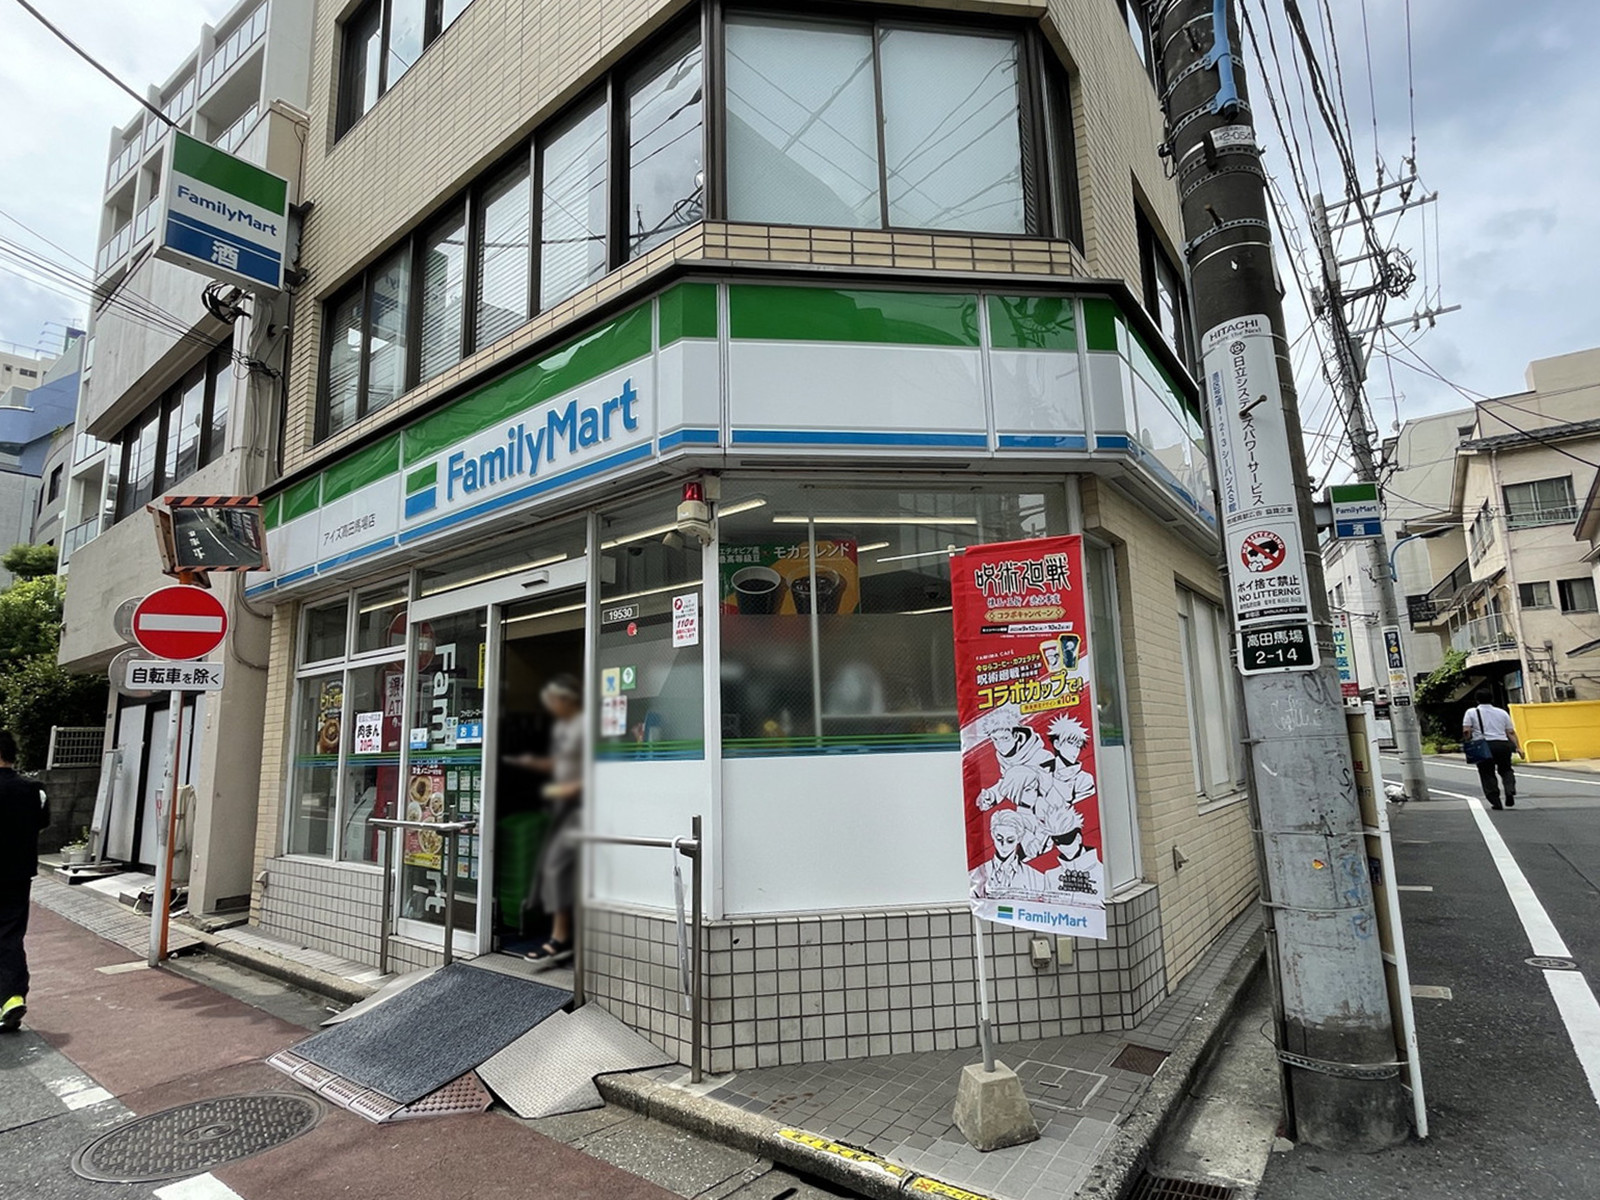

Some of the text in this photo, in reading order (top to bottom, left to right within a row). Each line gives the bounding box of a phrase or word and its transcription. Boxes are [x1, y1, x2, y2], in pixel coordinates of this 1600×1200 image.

[177, 184, 278, 238] FamilyMart
[211, 239, 240, 269] 酒
[1209, 319, 1259, 341] HITACHI
[447, 379, 639, 502] FamilyMart
[1335, 503, 1378, 515] FamilyMart
[1352, 523, 1366, 536] 酒
[974, 553, 1072, 596] 呪術廻戦
[1237, 574, 1300, 593] ポイ捨て禁止
[1238, 587, 1301, 603] NO LITTERING
[608, 607, 633, 621] 19530
[1246, 629, 1304, 648] 高田馬場
[1255, 648, 1299, 665] 2-14
[132, 667, 220, 685] 自転車を除く
[388, 700, 403, 715] AT
[357, 724, 380, 738] 肉まん
[1017, 907, 1088, 928] FamilyMart
